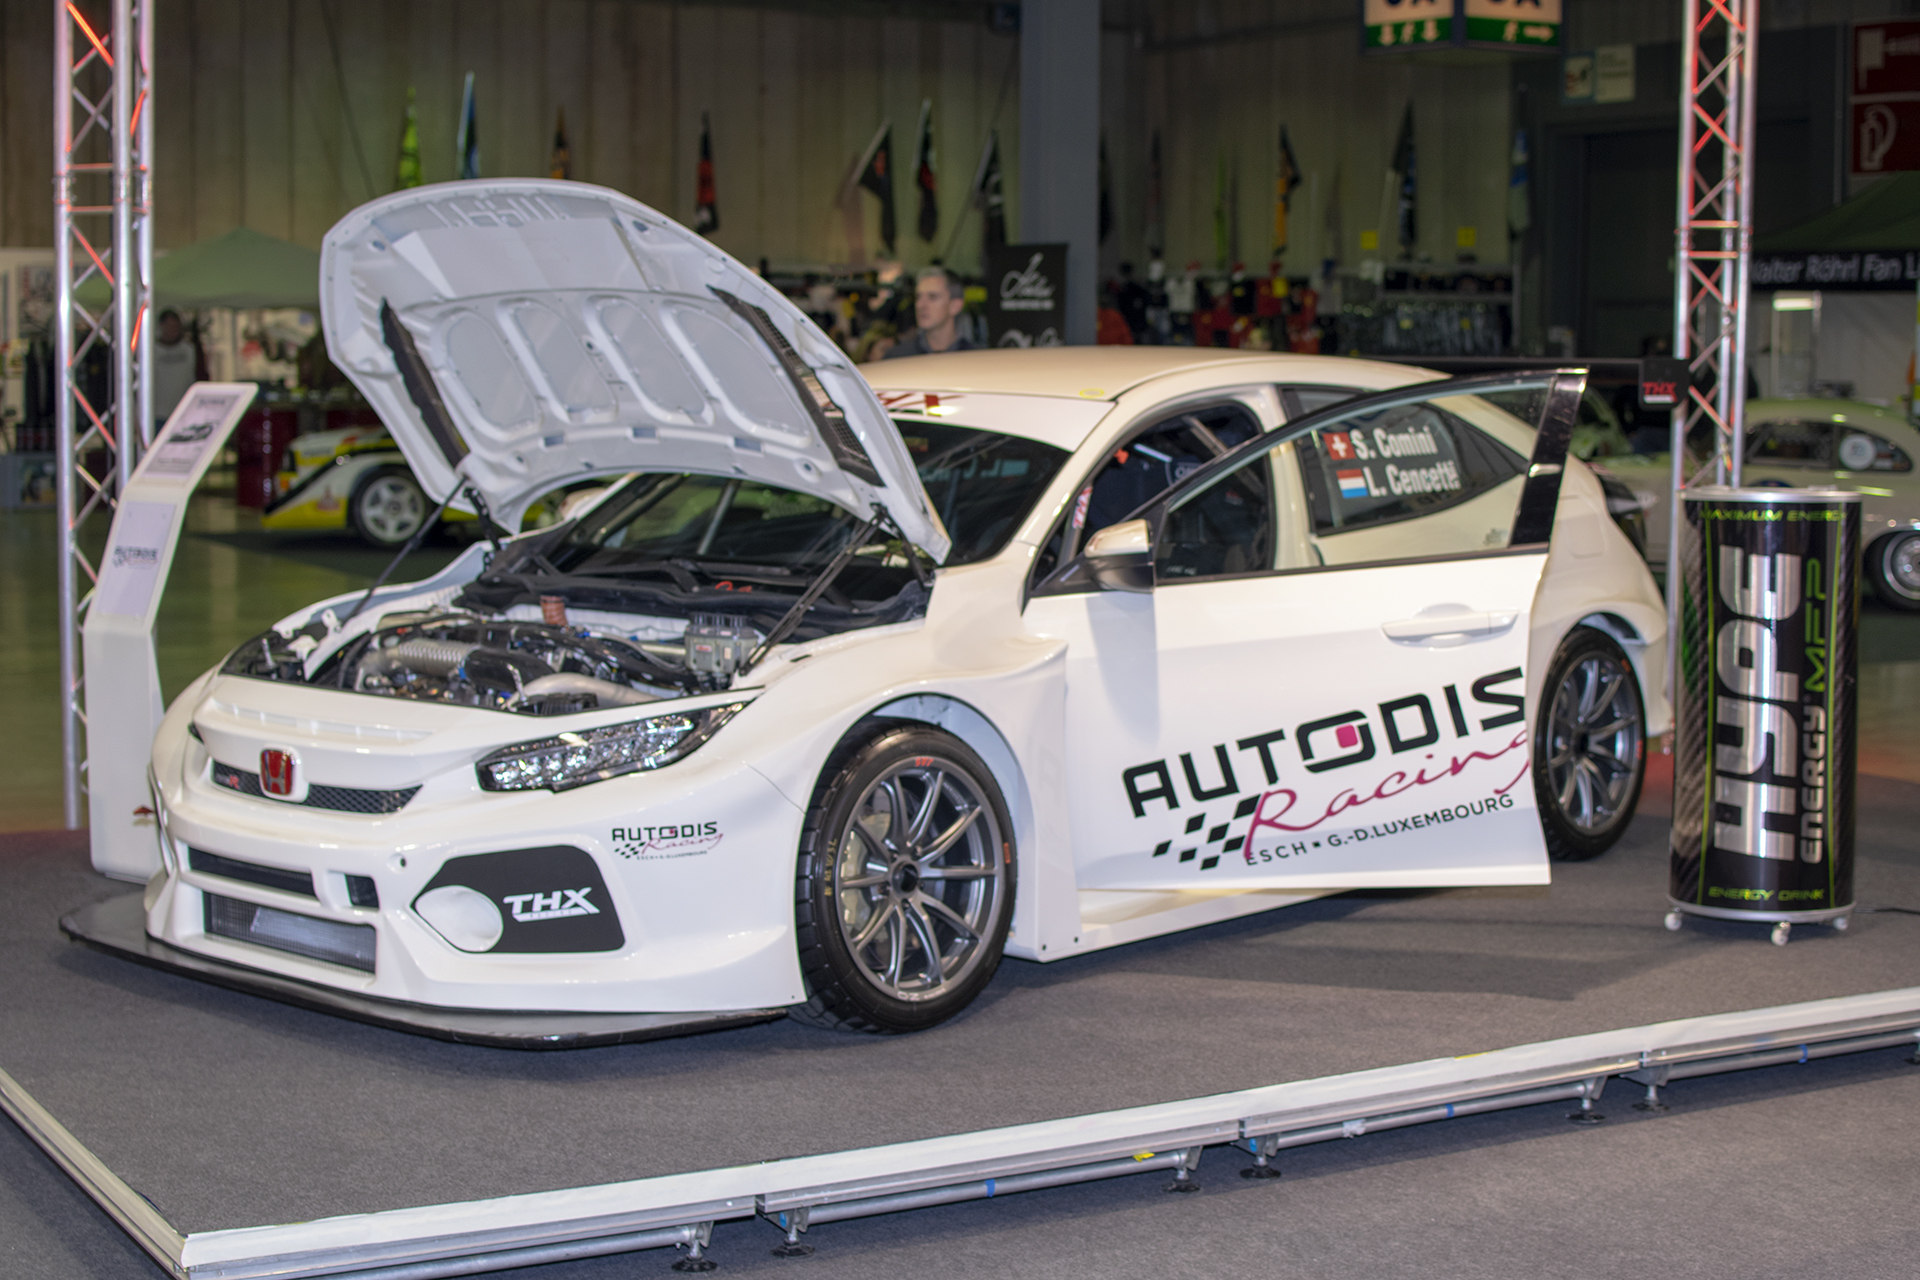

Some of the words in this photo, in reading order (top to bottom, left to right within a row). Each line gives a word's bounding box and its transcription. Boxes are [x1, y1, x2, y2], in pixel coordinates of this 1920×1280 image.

[1750, 258, 1803, 283] alter
[1806, 254, 1859, 282] Röhrl
[1863, 253, 1901, 281] Fan
[1350, 428, 1376, 460] S.
[1373, 425, 1438, 458] Comini
[1362, 466, 1387, 497] L.
[1385, 460, 1461, 496] Cencetti
[1804, 558, 1827, 693] MFP
[1714, 544, 1801, 861] HYPE
[1122, 666, 1526, 818] AUTODIS
[1243, 729, 1530, 861] Racing
[611, 821, 718, 842] AUTODIS
[641, 833, 723, 855] Racing
[1246, 840, 1307, 866] ESCH
[503, 887, 600, 915] THX
[1708, 886, 1775, 901] ENERGY
[1777, 888, 1825, 901] DRINK
